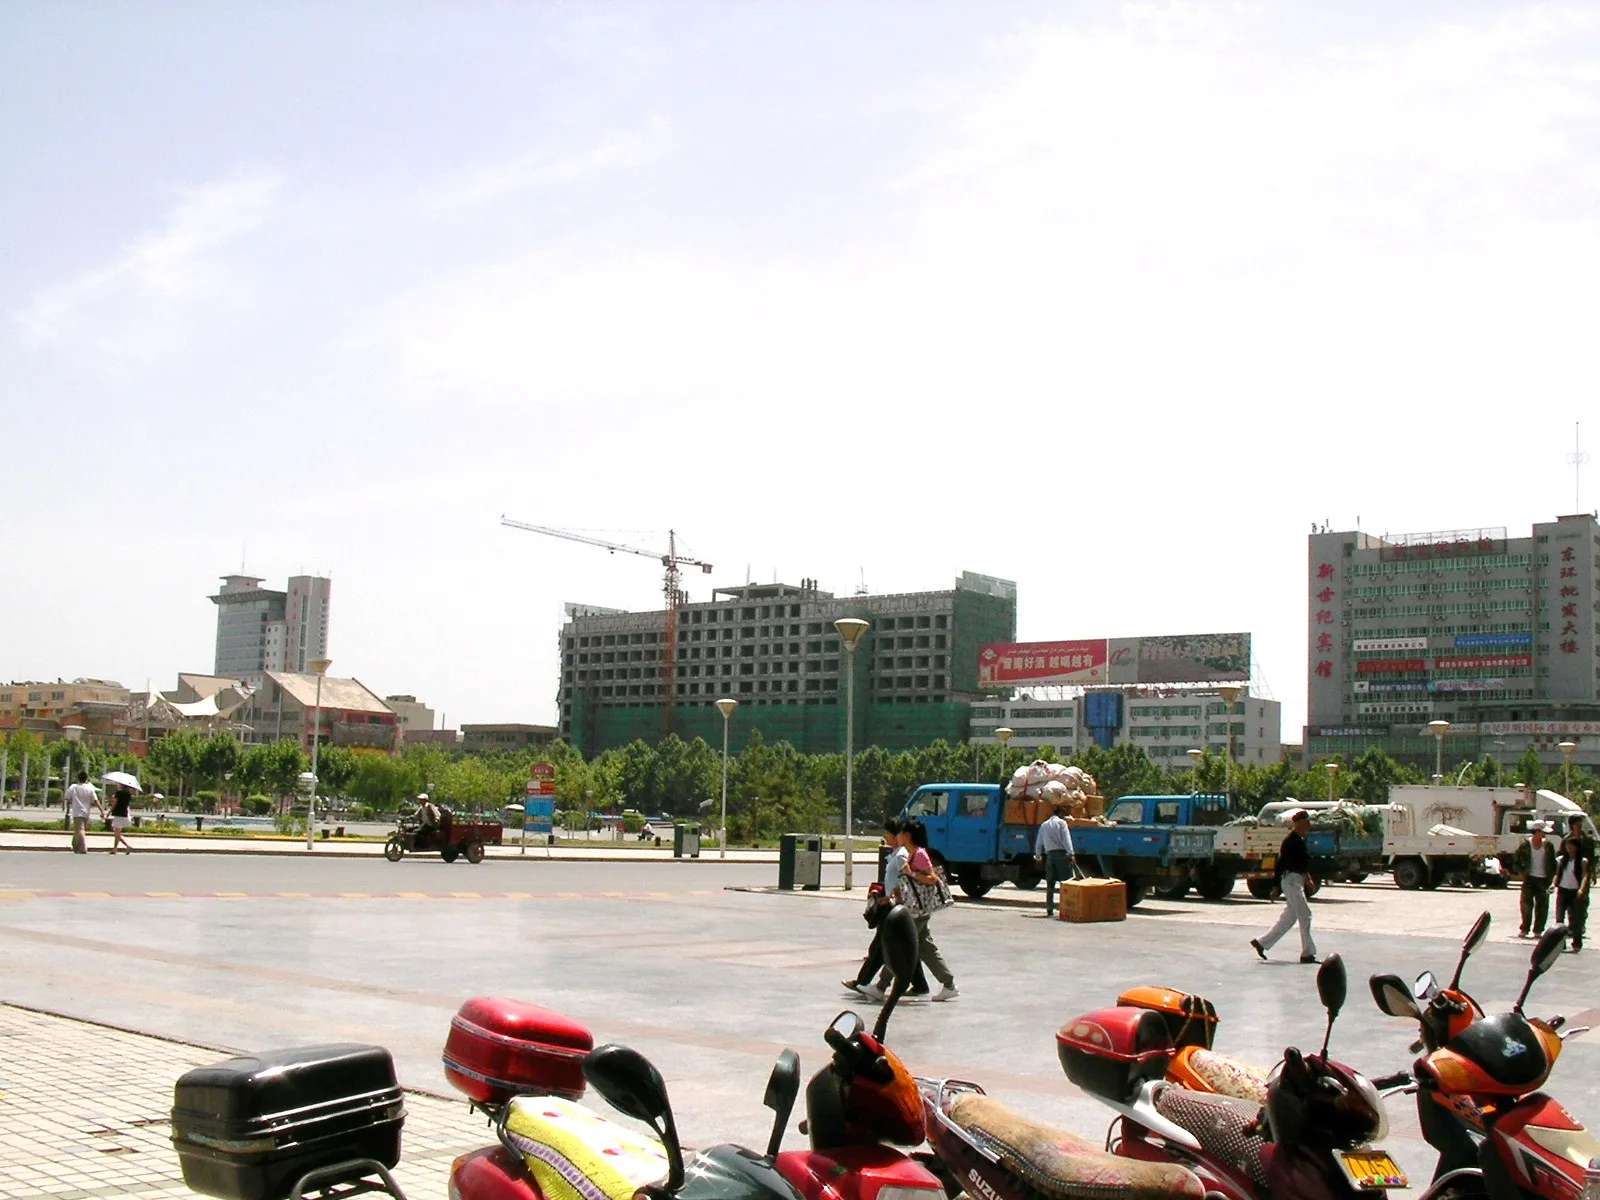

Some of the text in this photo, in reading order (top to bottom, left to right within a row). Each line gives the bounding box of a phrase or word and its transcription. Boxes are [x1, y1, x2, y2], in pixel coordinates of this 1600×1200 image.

[1315, 562, 1335, 679] 新世纪宾馆
[969, 1168, 1003, 1200] SUZU
